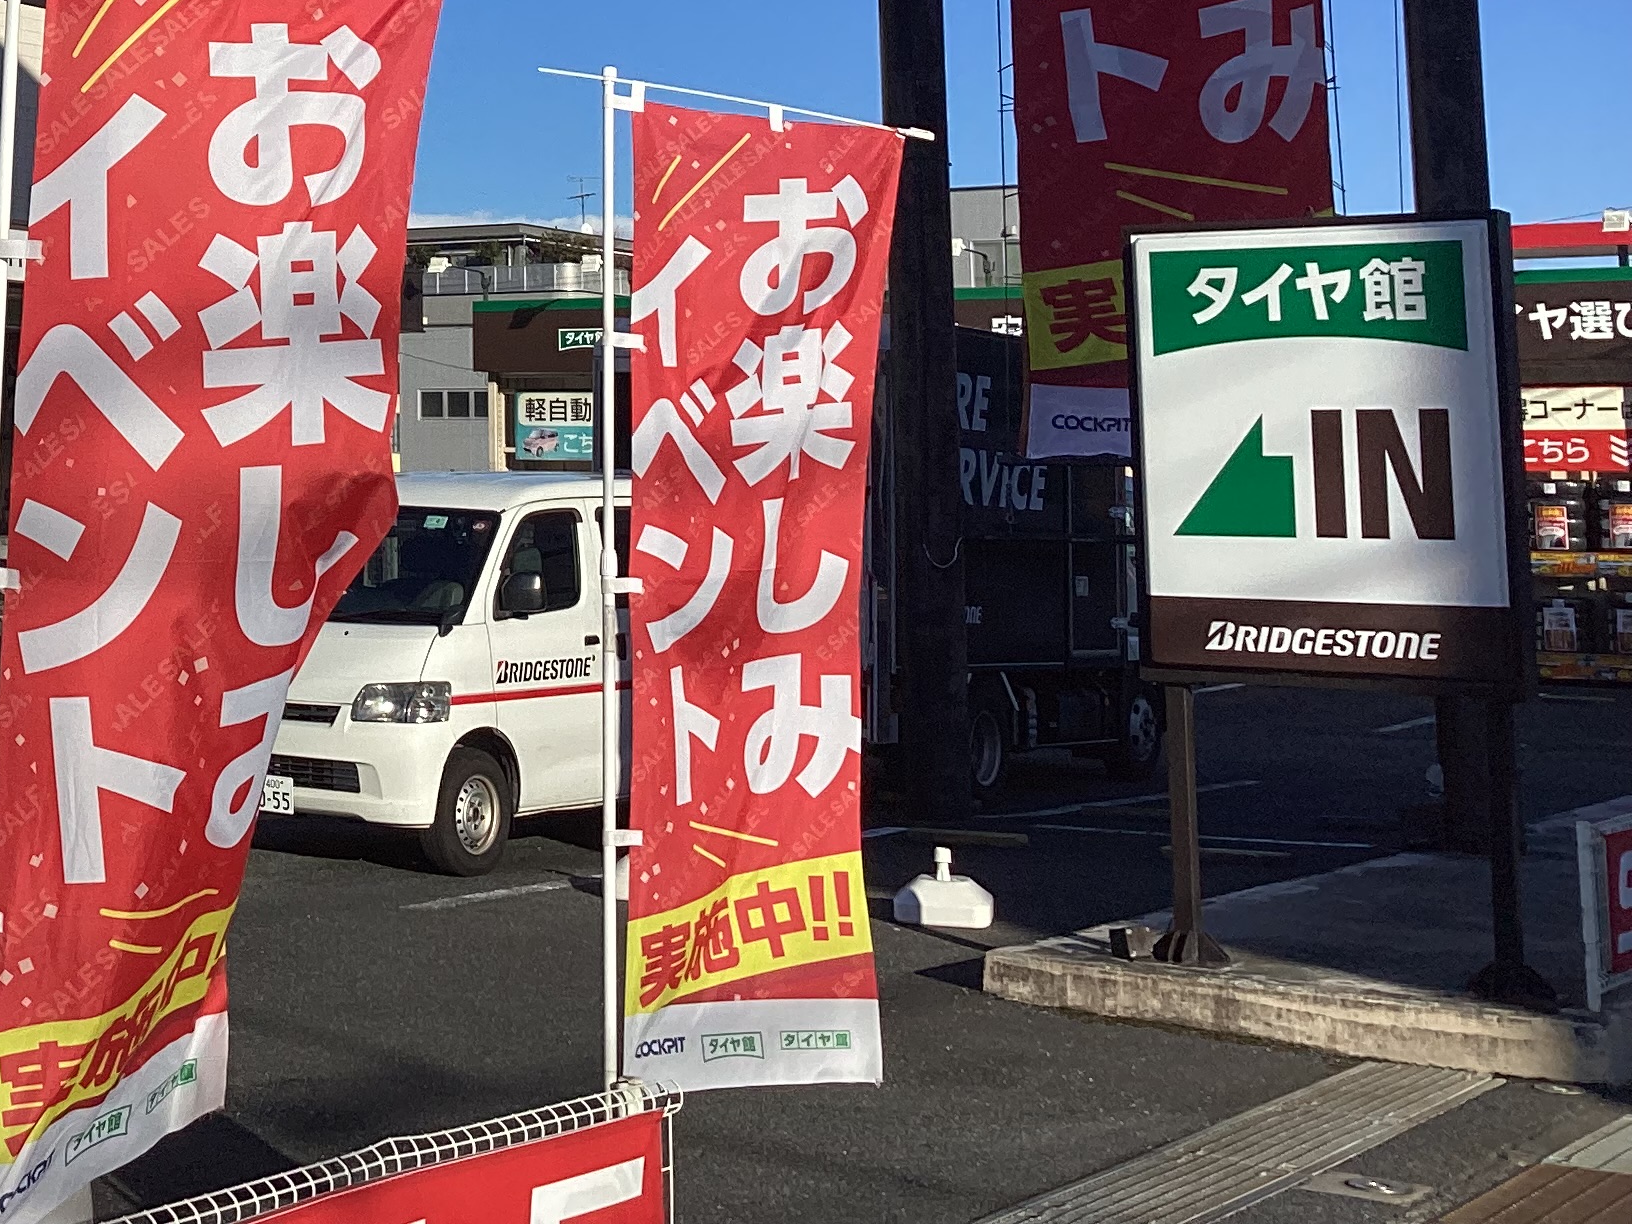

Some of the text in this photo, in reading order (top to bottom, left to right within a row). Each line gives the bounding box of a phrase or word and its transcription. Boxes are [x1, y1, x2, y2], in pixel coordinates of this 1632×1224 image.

[1186, 256, 1428, 326] タイヤ館
[14, 94, 186, 883] イベント
[631, 235, 734, 806] イベント
[725, 174, 869, 798] お楽しみ
[1311, 408, 1456, 541] IN
[495, 656, 592, 685] BRIDGESTONE
[1206, 620, 1441, 661] BRIDGESTONE
[640, 871, 854, 1008] 実施中!!
[709, 1036, 756, 1054] タイヤ館
